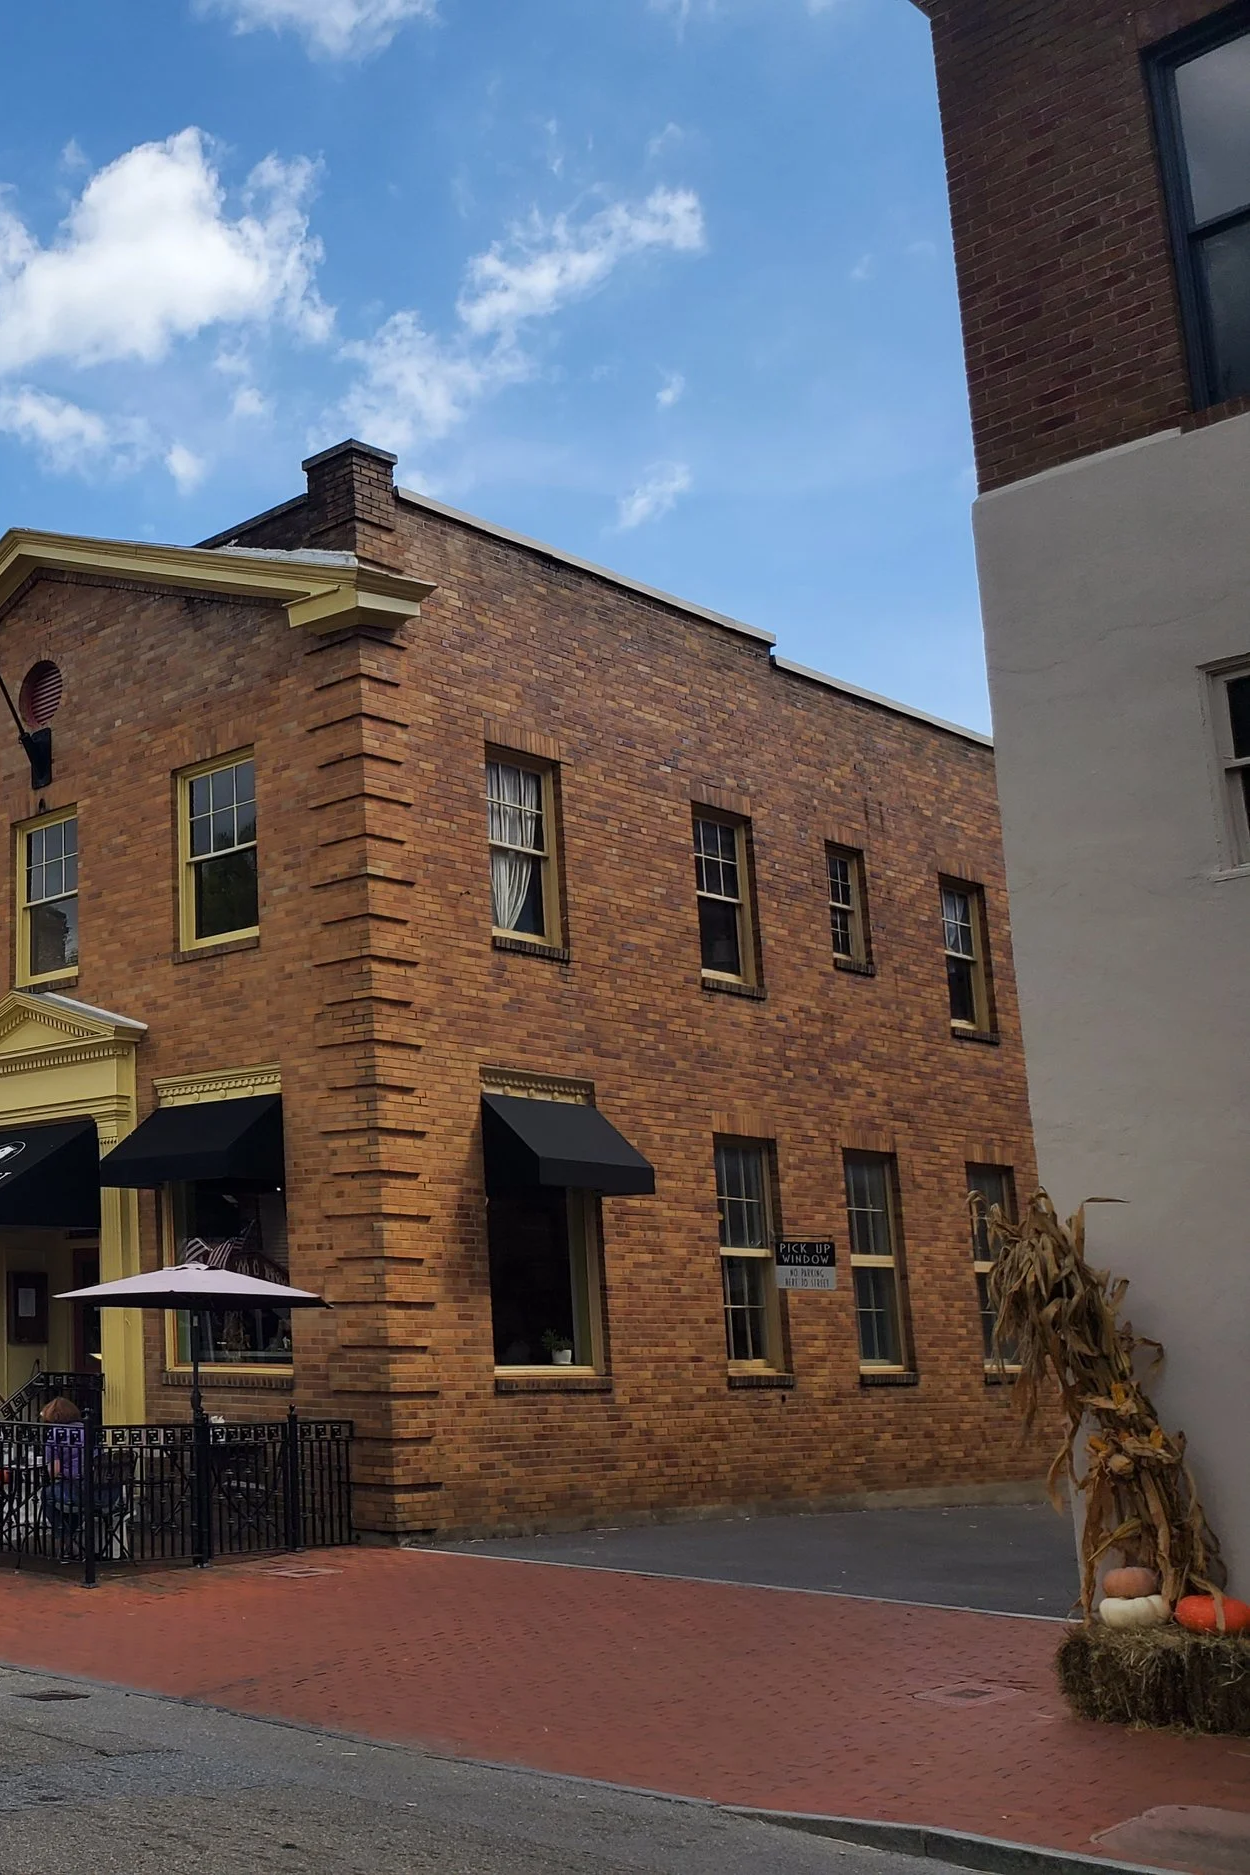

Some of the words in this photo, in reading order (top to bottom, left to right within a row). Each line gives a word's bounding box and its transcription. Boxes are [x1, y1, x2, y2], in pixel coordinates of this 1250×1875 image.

[779, 1242, 807, 1254] PICK
[815, 1243, 831, 1254] UP
[782, 1254, 829, 1264] WINDOW
[789, 1268, 798, 1277] NO
[800, 1268, 824, 1277] PARKING
[811, 1278, 829, 1288] STREET
